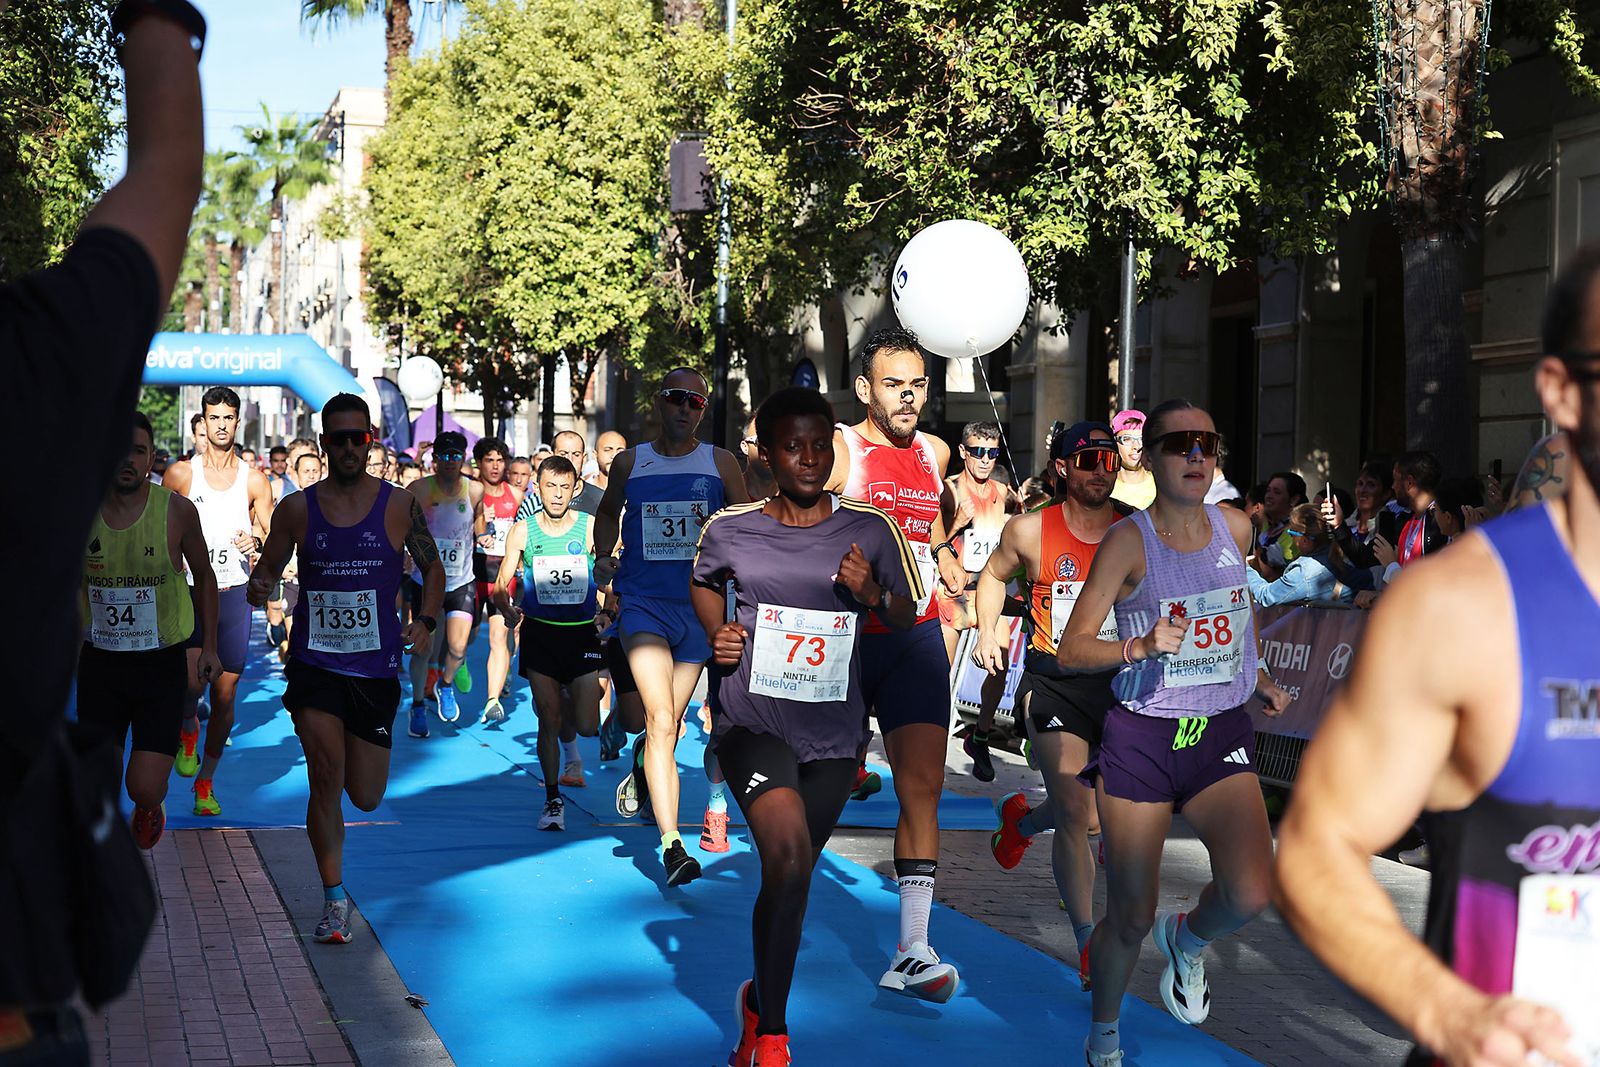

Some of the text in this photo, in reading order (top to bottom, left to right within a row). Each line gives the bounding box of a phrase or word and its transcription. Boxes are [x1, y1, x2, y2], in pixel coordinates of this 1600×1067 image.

[200, 346, 281, 374] original
[898, 487, 940, 502] ALTACASA
[662, 517, 687, 538] 31
[352, 560, 383, 568] CENTER
[322, 568, 368, 576] BELLAVISTA
[550, 570, 573, 586] 35
[116, 574, 166, 588] PIRÁMIDE
[106, 605, 136, 627] 34
[315, 608, 372, 630] 1339
[120, 629, 152, 638] CUADRADO
[1194, 615, 1233, 650] 58
[786, 634, 826, 666] 73
[1170, 656, 1215, 669] HERRERO
[782, 672, 818, 682] NINTIJE
[1170, 664, 1216, 678] Huelva
[755, 674, 801, 691] Huelva
